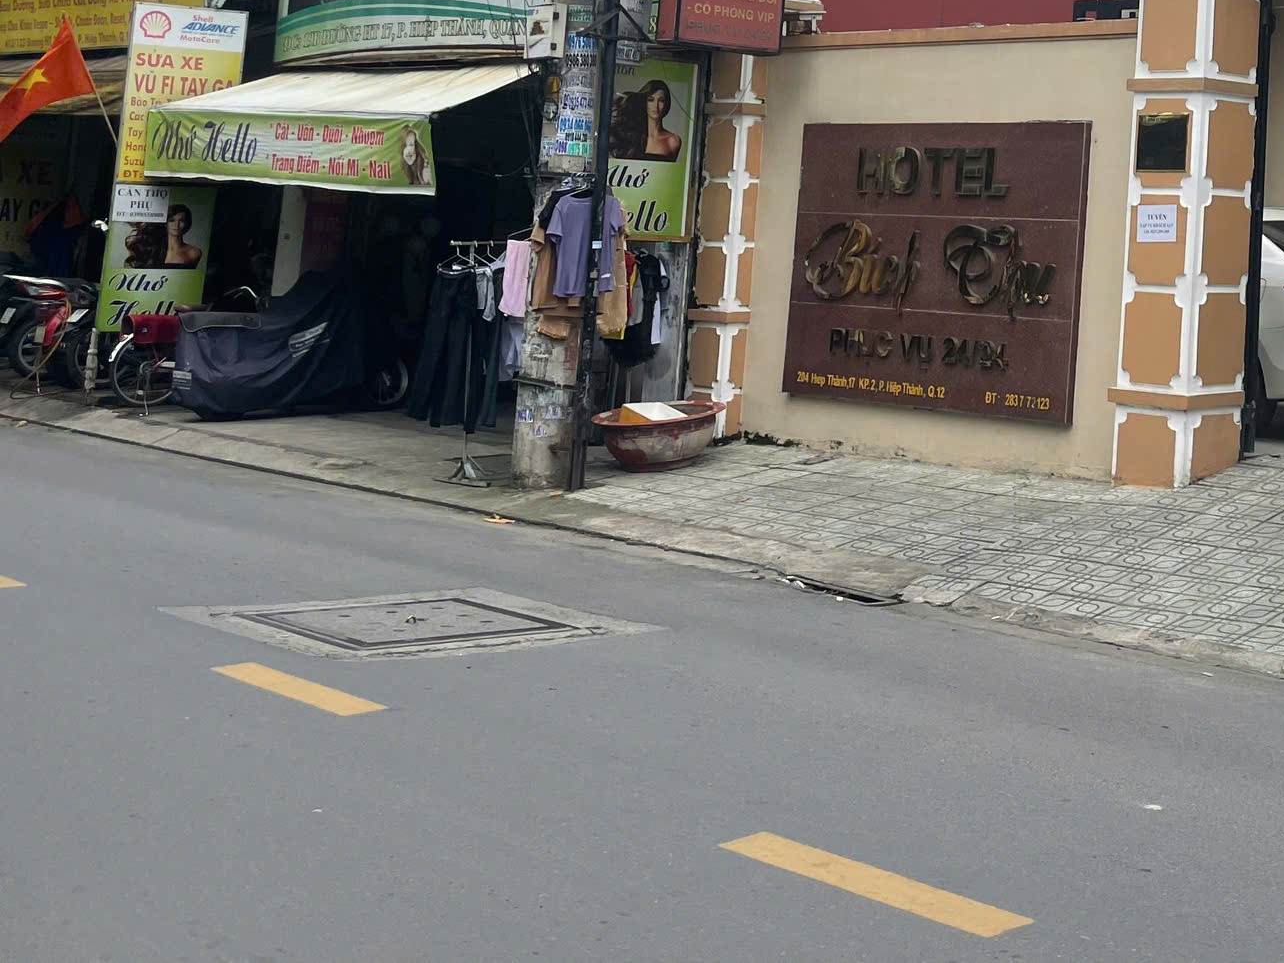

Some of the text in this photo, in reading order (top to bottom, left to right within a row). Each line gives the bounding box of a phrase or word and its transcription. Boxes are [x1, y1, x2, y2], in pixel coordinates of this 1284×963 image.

[757, 11, 775, 23] VIP
[182, 21, 241, 35] ADVANCE
[180, 34, 221, 44] MotoCare
[180, 55, 204, 71] XE
[161, 75, 175, 95] FI
[180, 76, 208, 97] TAY
[128, 126, 144, 139] Tay
[201, 119, 257, 166] Hello
[271, 153, 295, 174] Trang
[346, 158, 359, 177] Mi
[369, 160, 391, 179] Nail
[856, 146, 1011, 198] HOTEL
[796, 371, 809, 383] 204
[927, 385, 945, 399] Q.12
